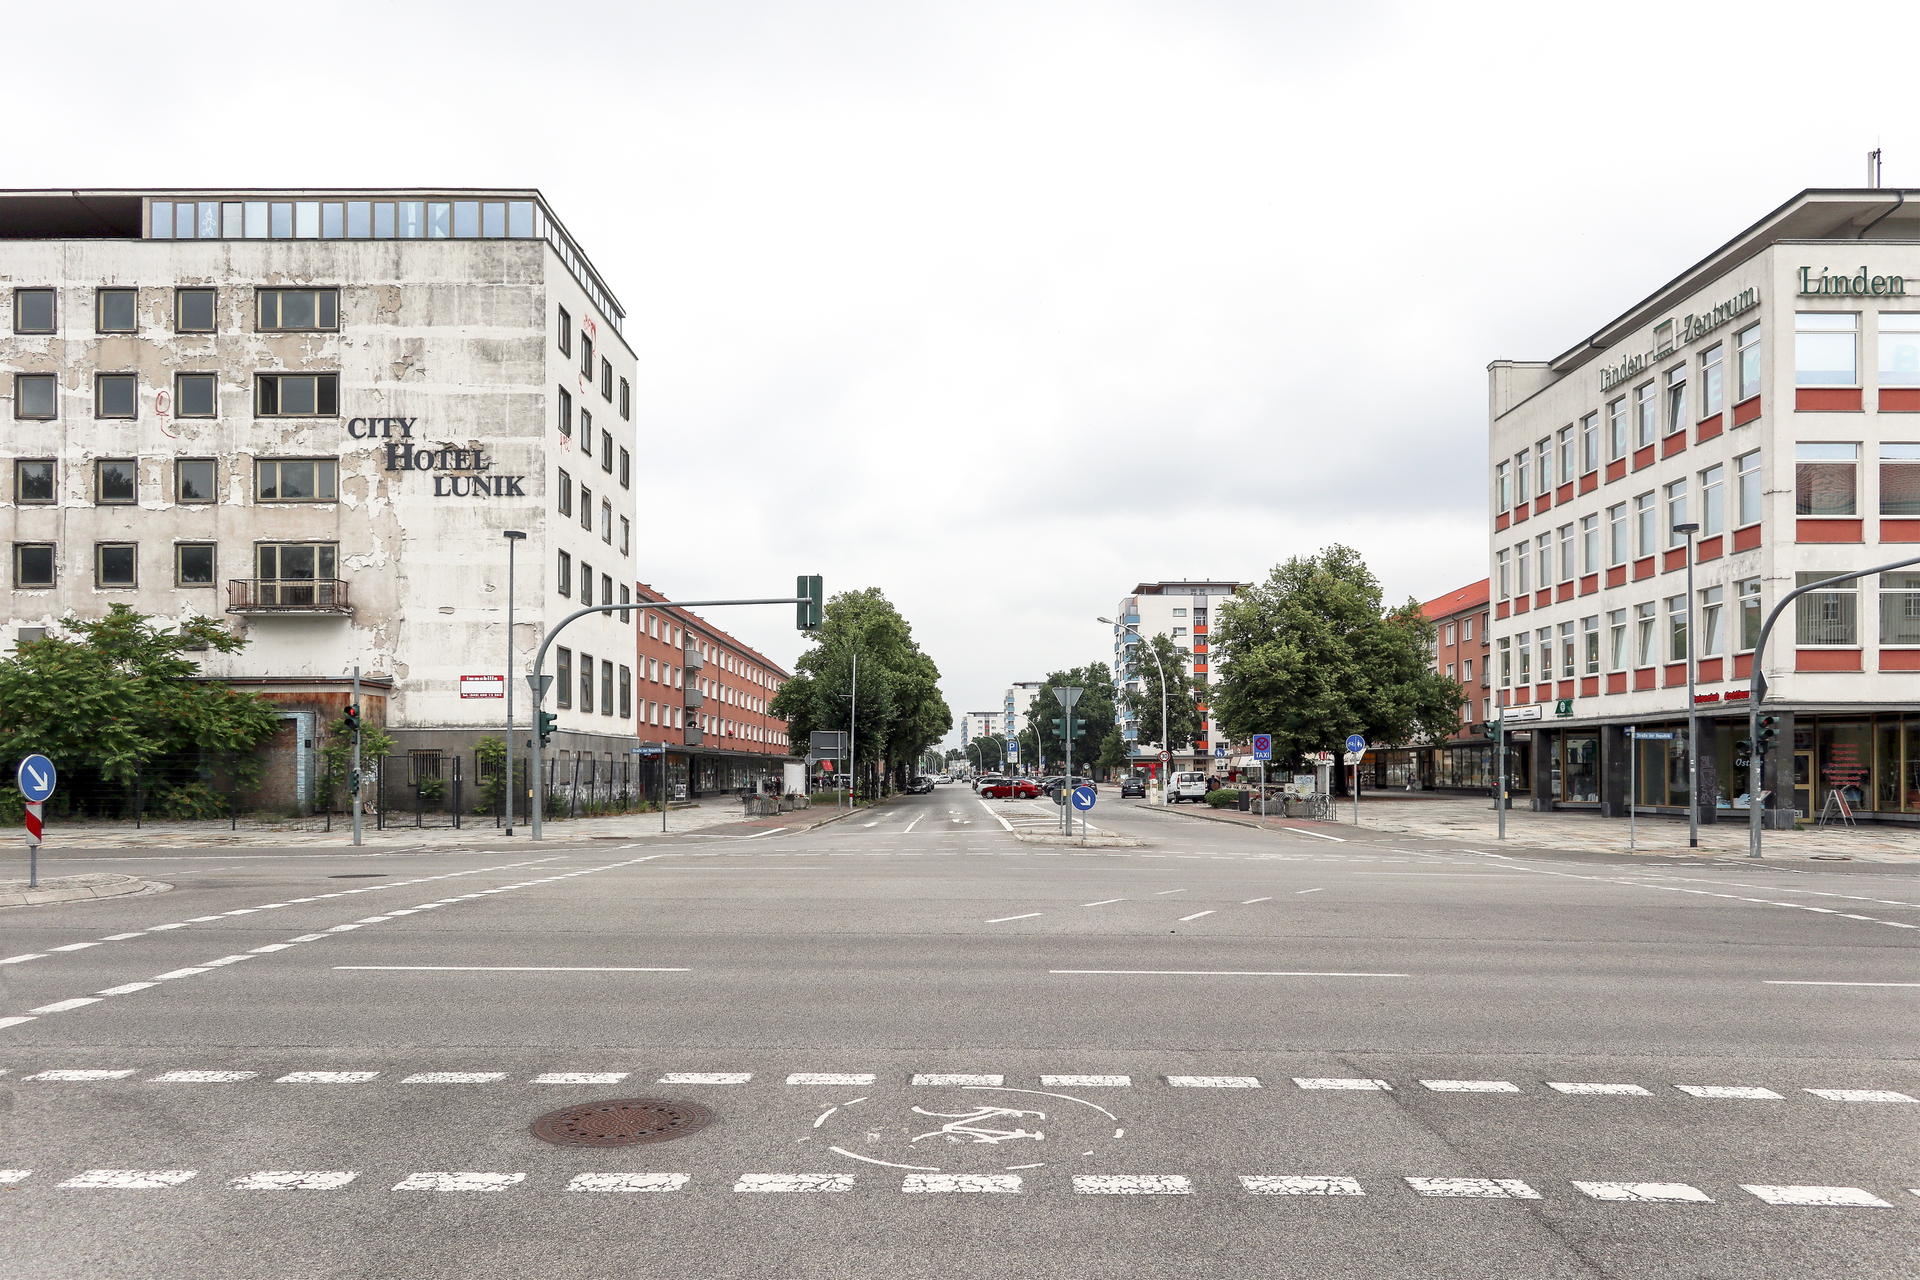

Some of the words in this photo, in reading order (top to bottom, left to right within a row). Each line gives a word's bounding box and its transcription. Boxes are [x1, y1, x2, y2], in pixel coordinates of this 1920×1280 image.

[1799, 265, 1906, 296] Linden
[1599, 354, 1645, 392] Linden
[1683, 286, 1759, 343] Zentrum
[348, 417, 418, 439] CITY
[385, 443, 490, 471] HOTEL
[433, 475, 526, 497] LUNIK
